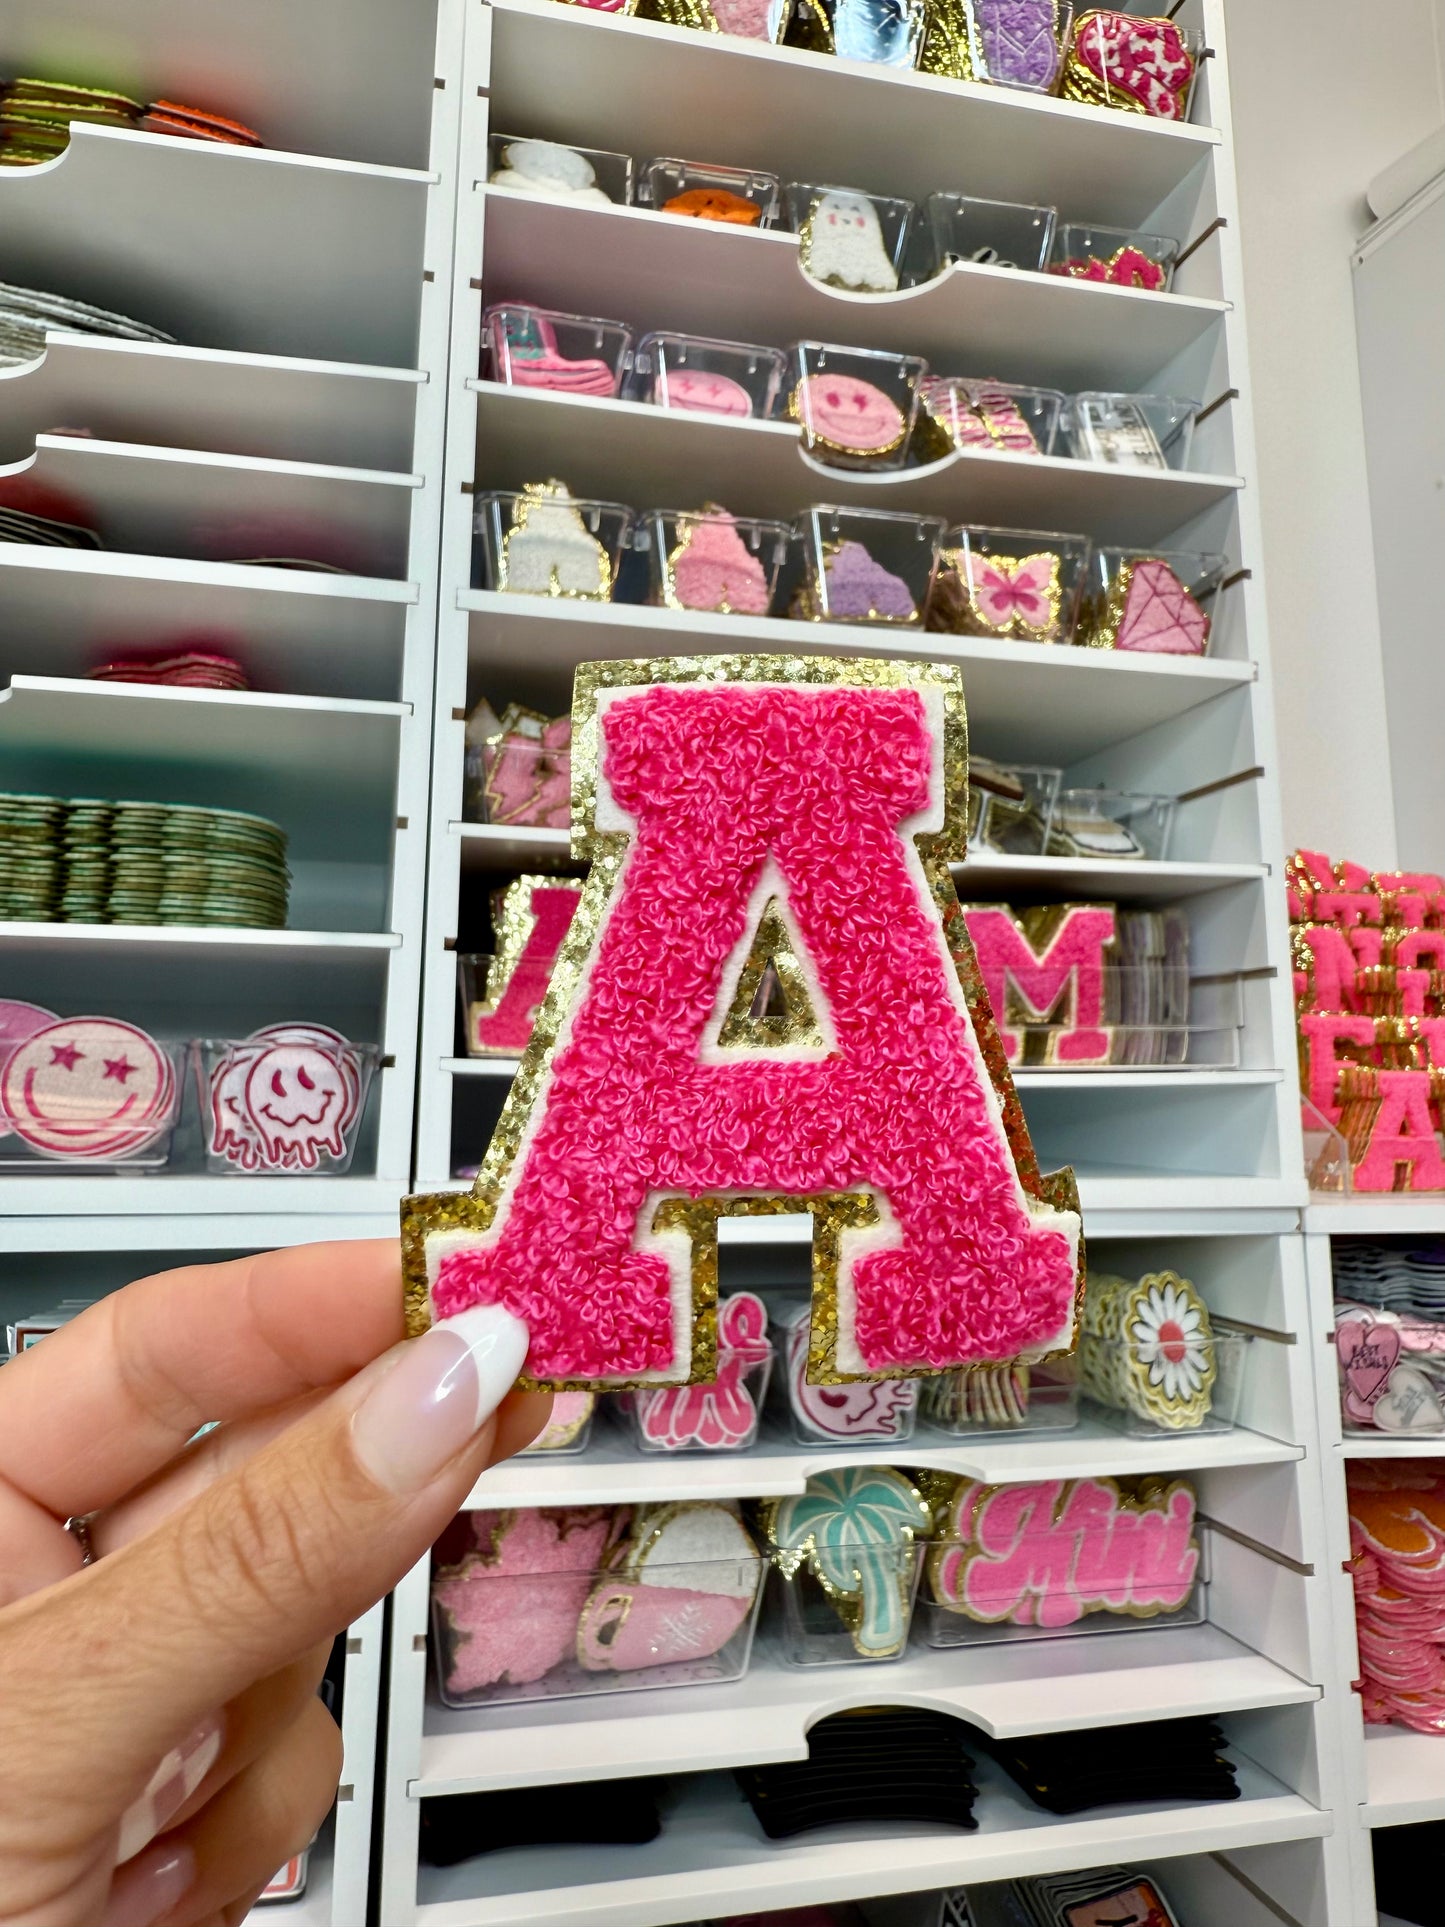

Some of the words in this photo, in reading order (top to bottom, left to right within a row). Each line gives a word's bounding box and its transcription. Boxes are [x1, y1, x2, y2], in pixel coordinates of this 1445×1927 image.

[428, 682, 1080, 1382] A
[962, 906, 1116, 1061] M
[1353, 1069, 1445, 1191] A
